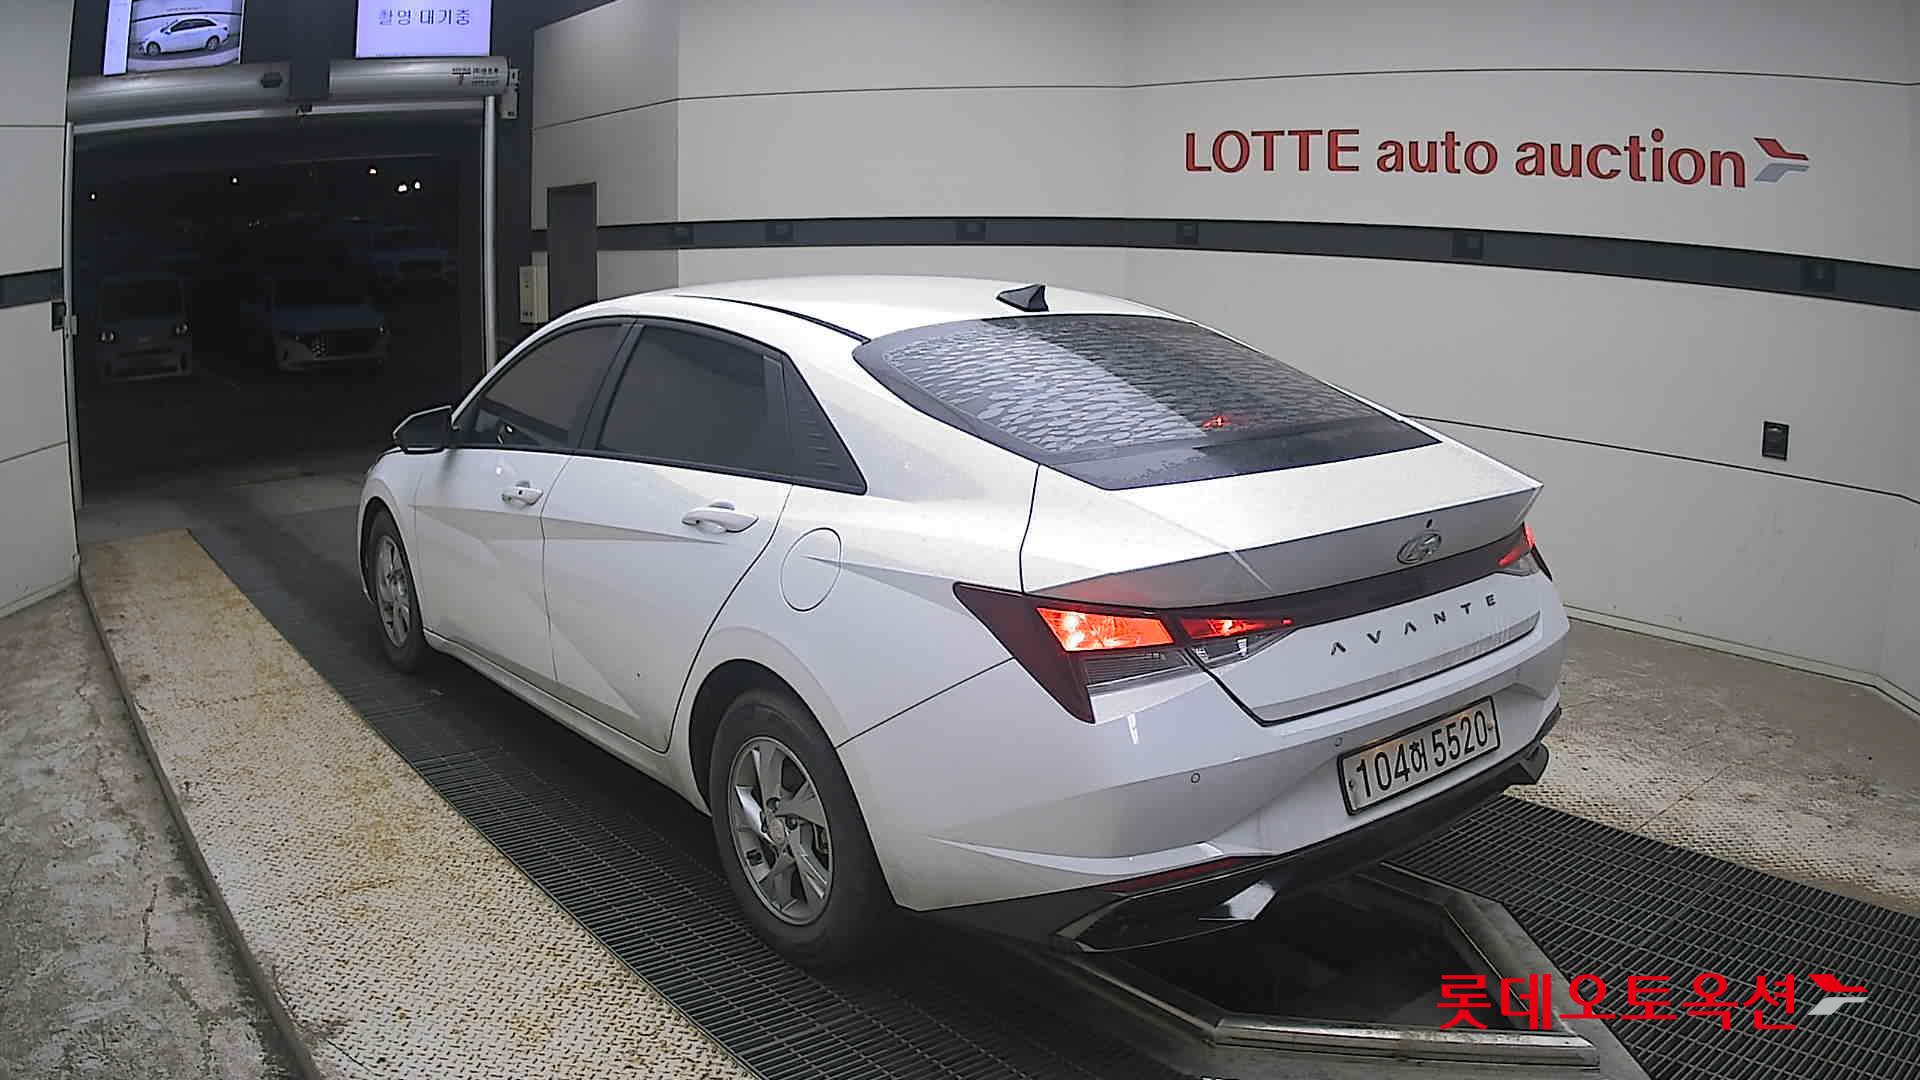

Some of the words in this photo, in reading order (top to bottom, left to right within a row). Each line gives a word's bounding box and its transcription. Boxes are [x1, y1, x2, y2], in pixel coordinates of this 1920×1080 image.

[419, 8, 470, 26] 대기중
[1184, 128, 1360, 174] LOTTE
[1376, 131, 1498, 175] auto
[1514, 128, 1746, 188] auction
[1330, 593, 1497, 656] AVANTE
[1431, 710, 1488, 768] 5520
